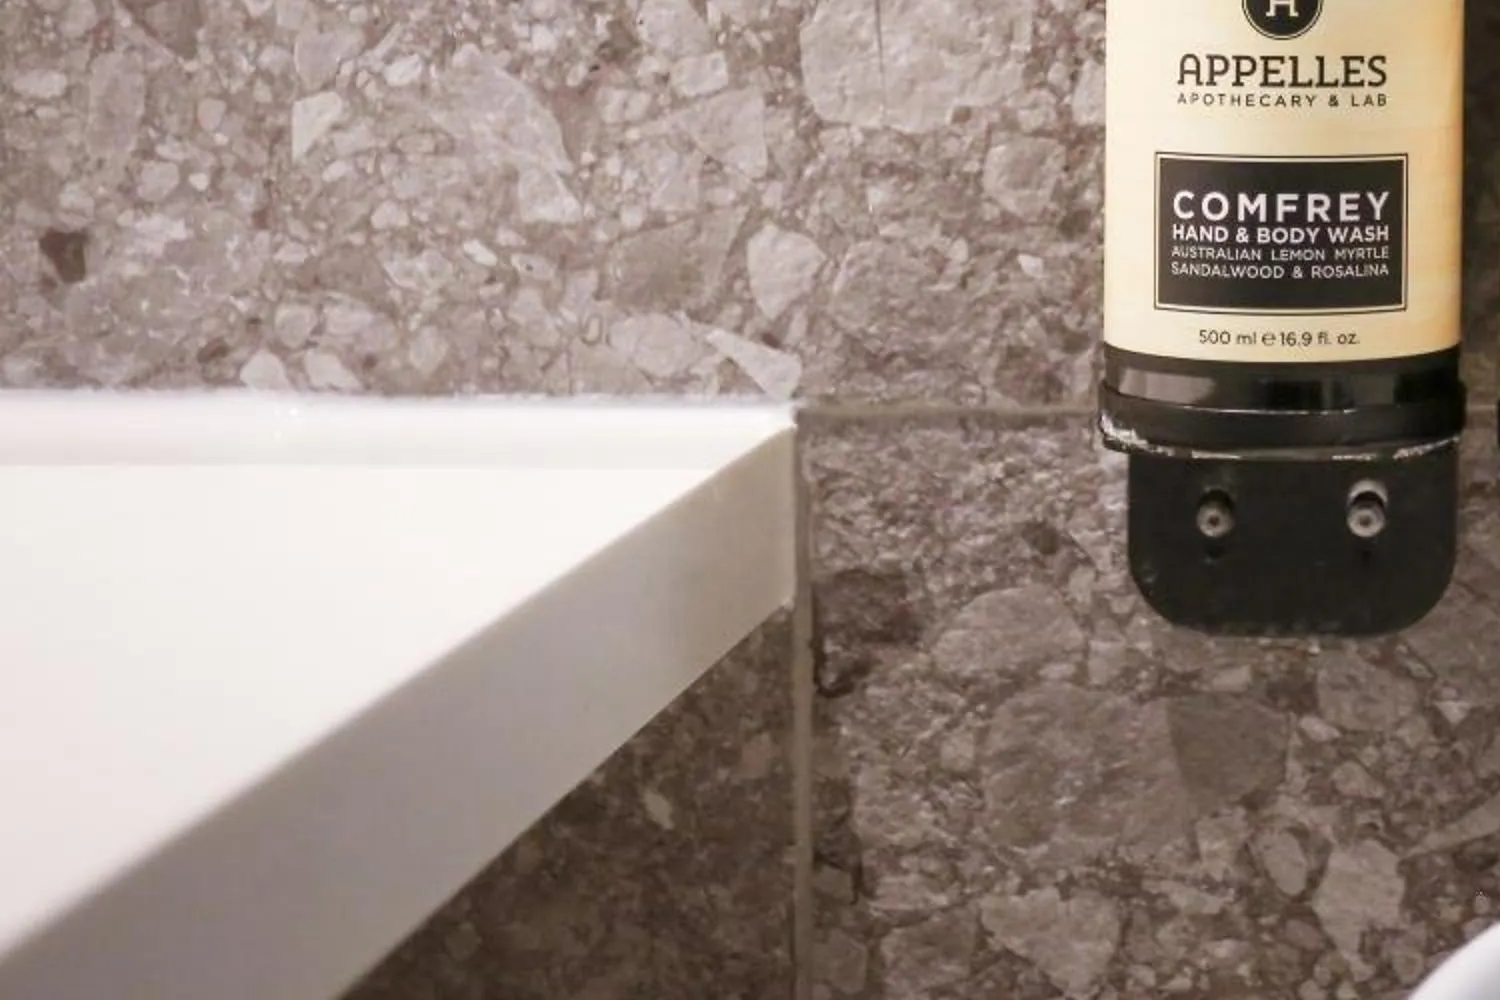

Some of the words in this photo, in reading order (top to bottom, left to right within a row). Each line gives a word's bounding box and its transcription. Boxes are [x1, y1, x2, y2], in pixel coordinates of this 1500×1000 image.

[1176, 53, 1389, 88] APPELLES
[1176, 92, 1318, 108] APOTHECARY
[1328, 94, 1340, 108] &
[1351, 93, 1388, 108] LAB
[1172, 189, 1390, 223] COMFREY
[1172, 224, 1229, 244] HAND
[1235, 228, 1250, 244] &
[1257, 227, 1321, 245] BODY
[1327, 225, 1389, 243] WASH
[1171, 246, 1262, 261] AUSTRALIAN
[1270, 248, 1326, 262] LEMON
[1334, 245, 1389, 260] MYRTLE
[1171, 261, 1285, 279] SANDALWOOD
[1292, 265, 1304, 279] &
[1311, 263, 1389, 279] ROSALINA
[1199, 329, 1231, 345] 500
[1236, 331, 1257, 345] ml
[1280, 332, 1313, 347] 16.9
